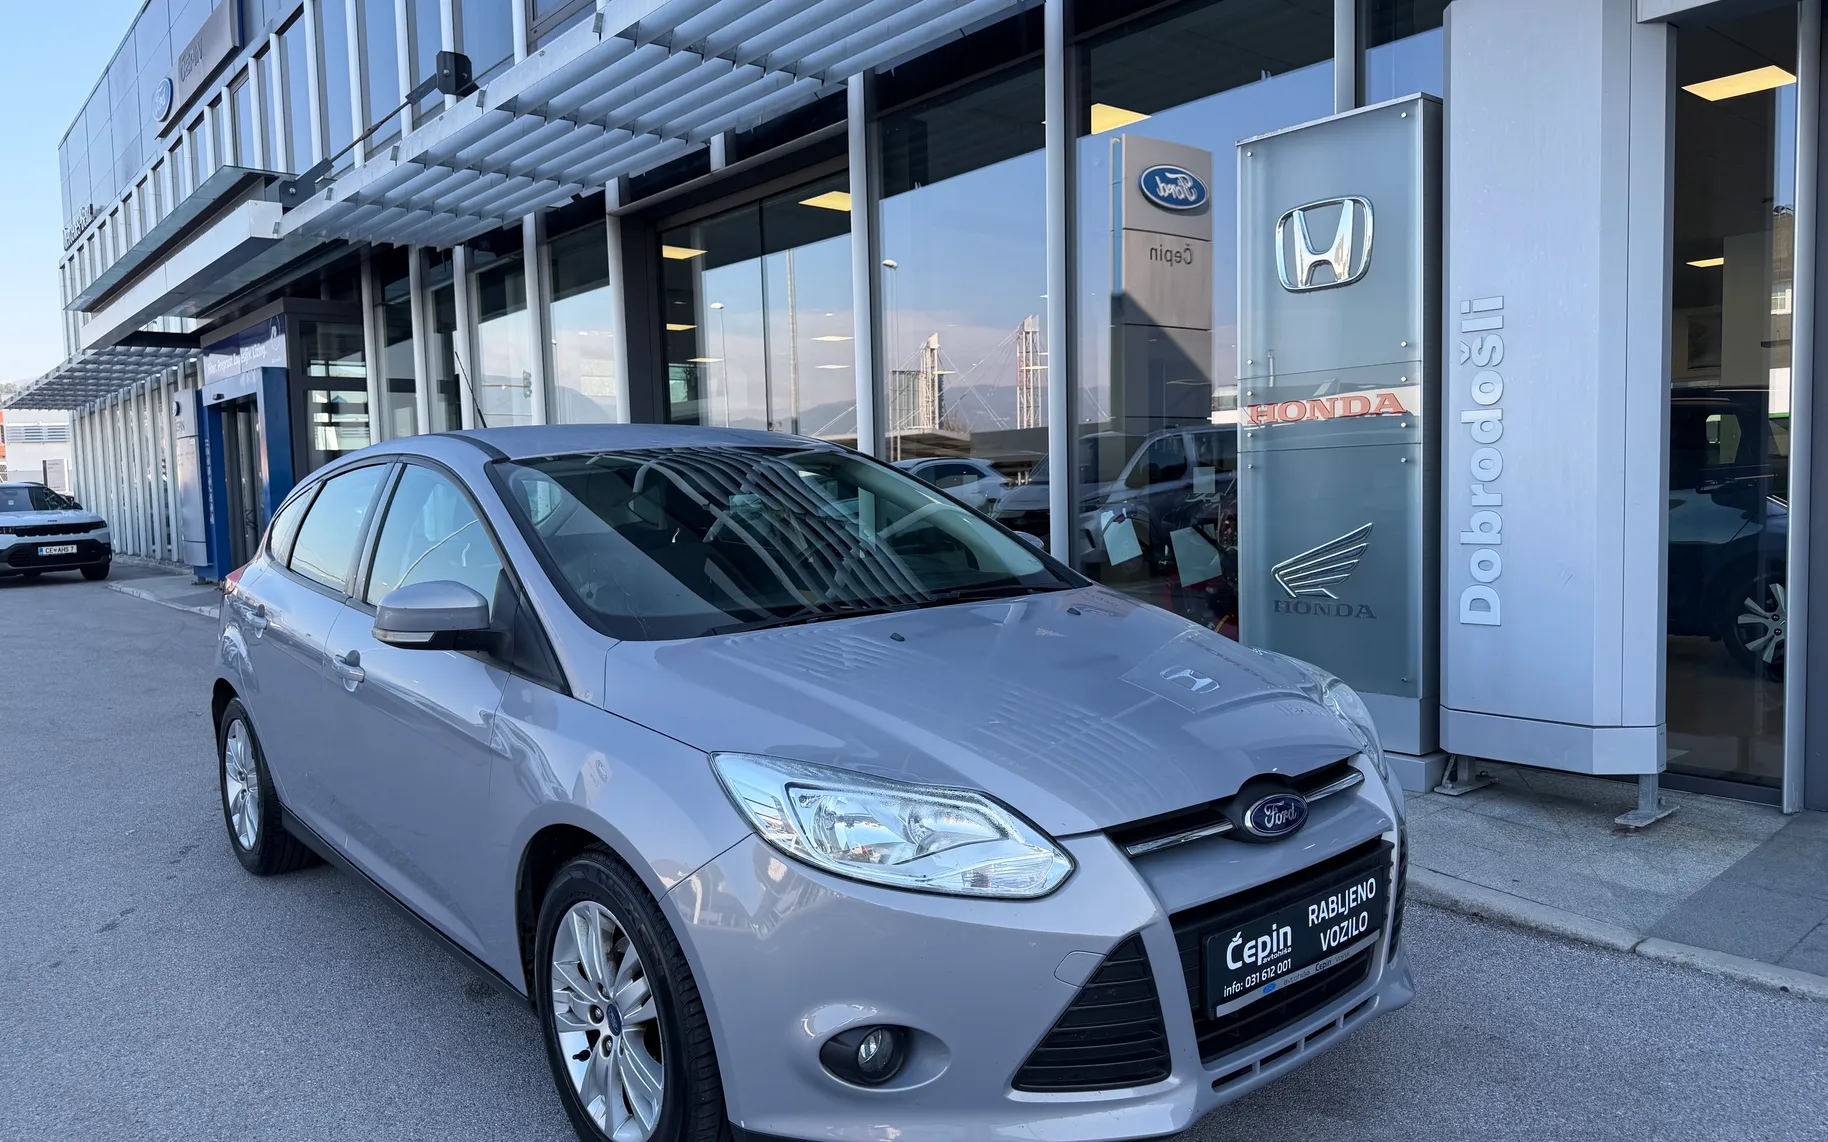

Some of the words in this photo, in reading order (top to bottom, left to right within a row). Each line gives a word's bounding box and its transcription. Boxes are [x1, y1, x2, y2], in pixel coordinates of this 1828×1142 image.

[1247, 393, 1408, 425] HONDA
[1460, 296, 1504, 626] Dobrodošli
[1273, 600, 1378, 619] HONDA
[1264, 800, 1298, 828] Ford
[1308, 877, 1376, 928] RABLJENO
[1226, 923, 1292, 970] Čepin
[1320, 911, 1368, 951] VOZILO
[1262, 946, 1292, 964] avtohiša
[1223, 981, 1243, 997] info:
[1245, 973, 1260, 988] 031
[1262, 966, 1276, 982] 612
[1277, 958, 1292, 975] 001
